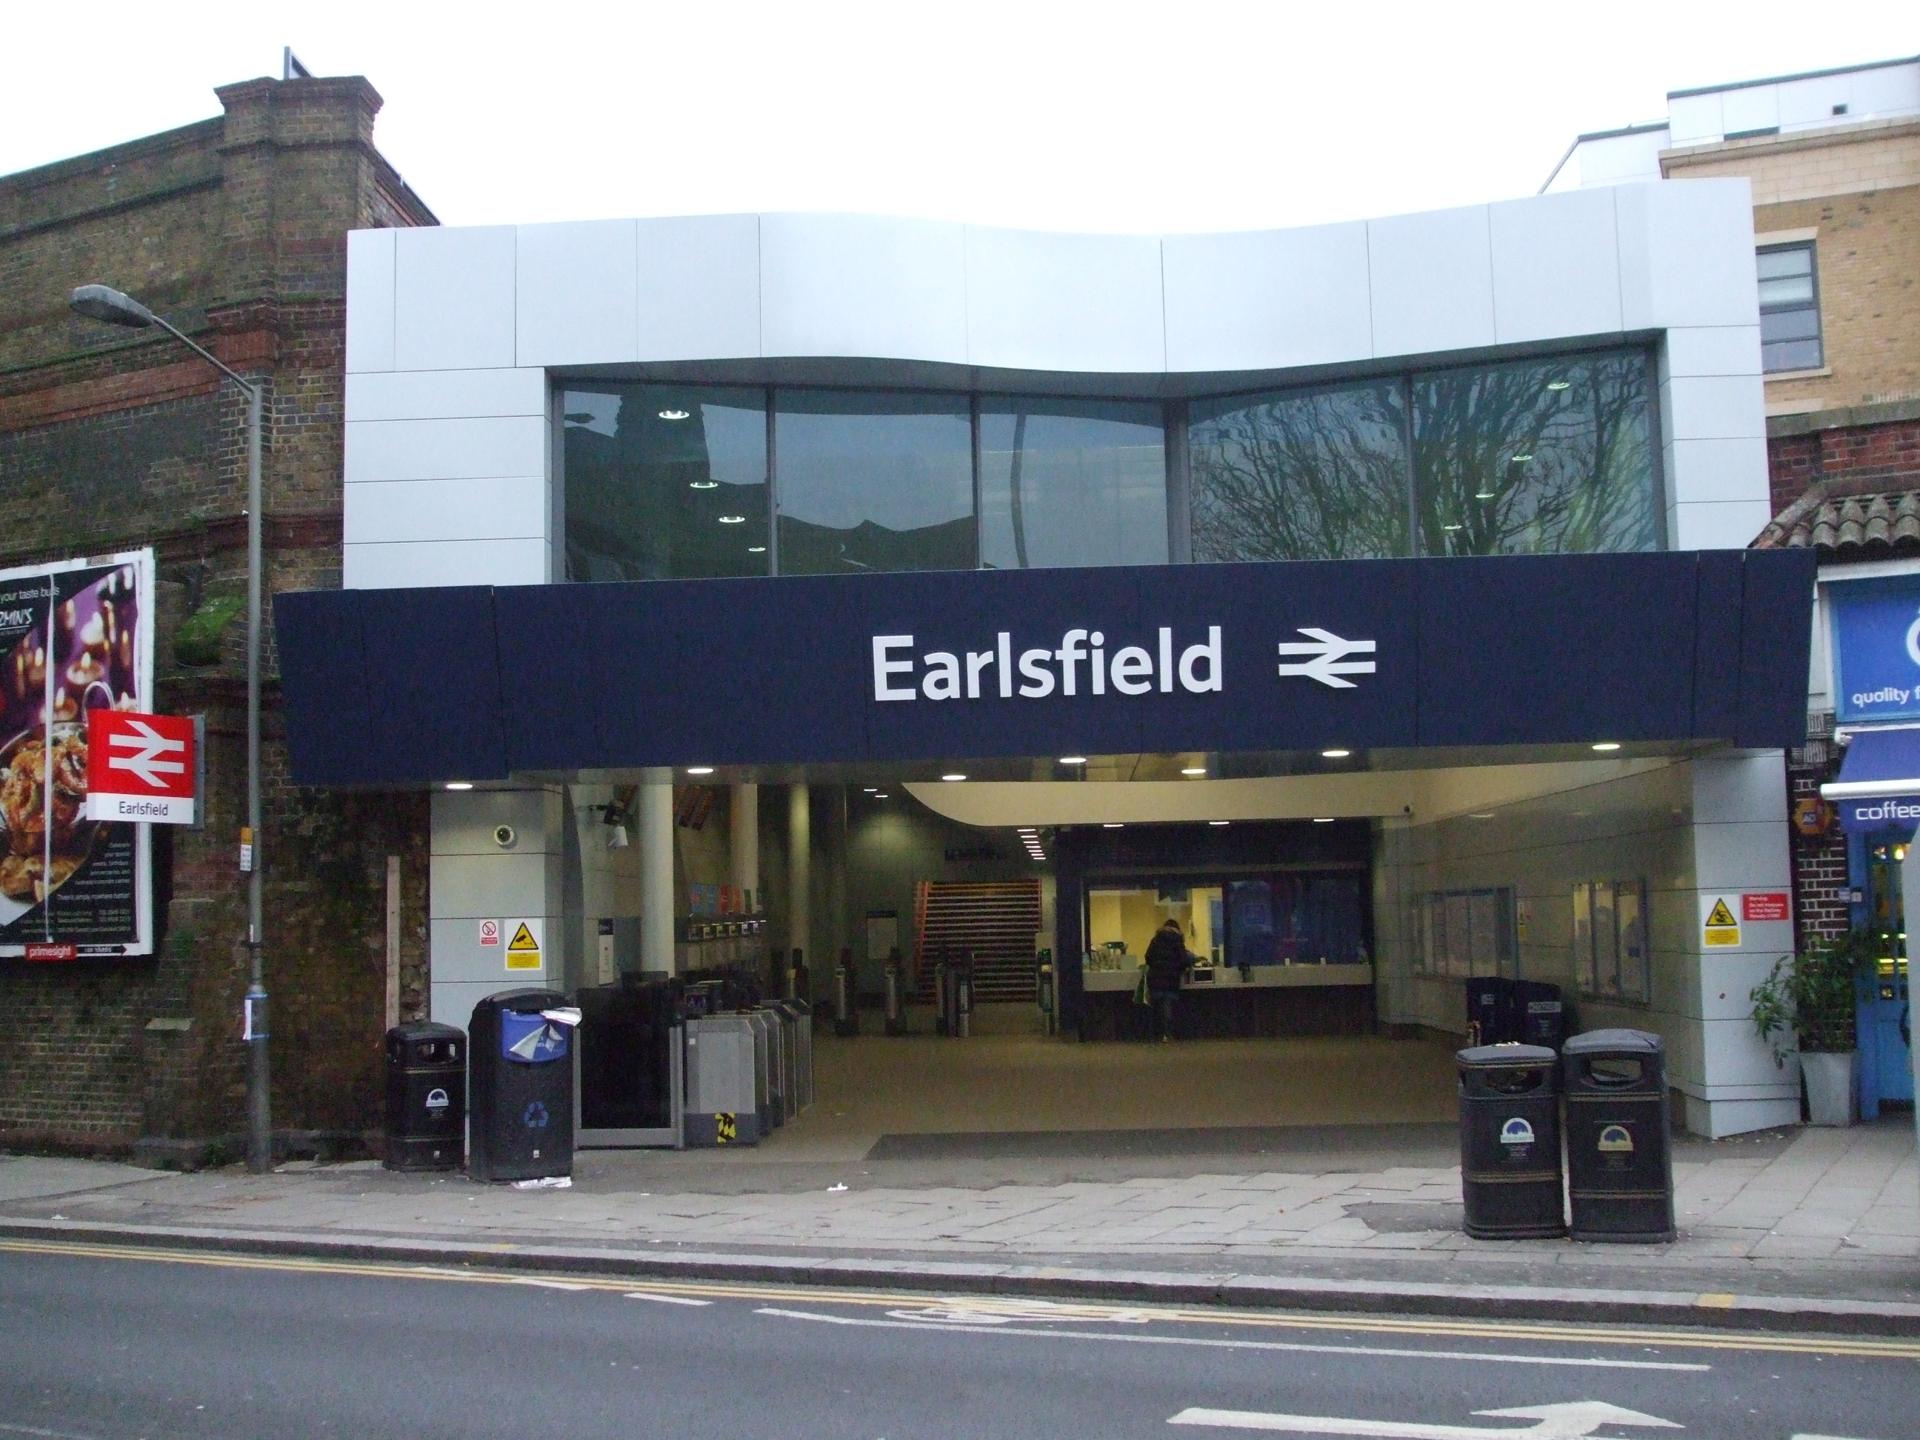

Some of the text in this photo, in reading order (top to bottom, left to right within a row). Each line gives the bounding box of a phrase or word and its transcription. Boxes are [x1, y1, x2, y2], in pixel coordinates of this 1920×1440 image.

[19, 589, 39, 599] taste
[873, 626, 1222, 701] Earlsfield
[1852, 687, 1910, 708] quality
[119, 801, 169, 816] Earlsfield
[1856, 801, 1920, 820] coffee
[29, 946, 71, 958] primesight
